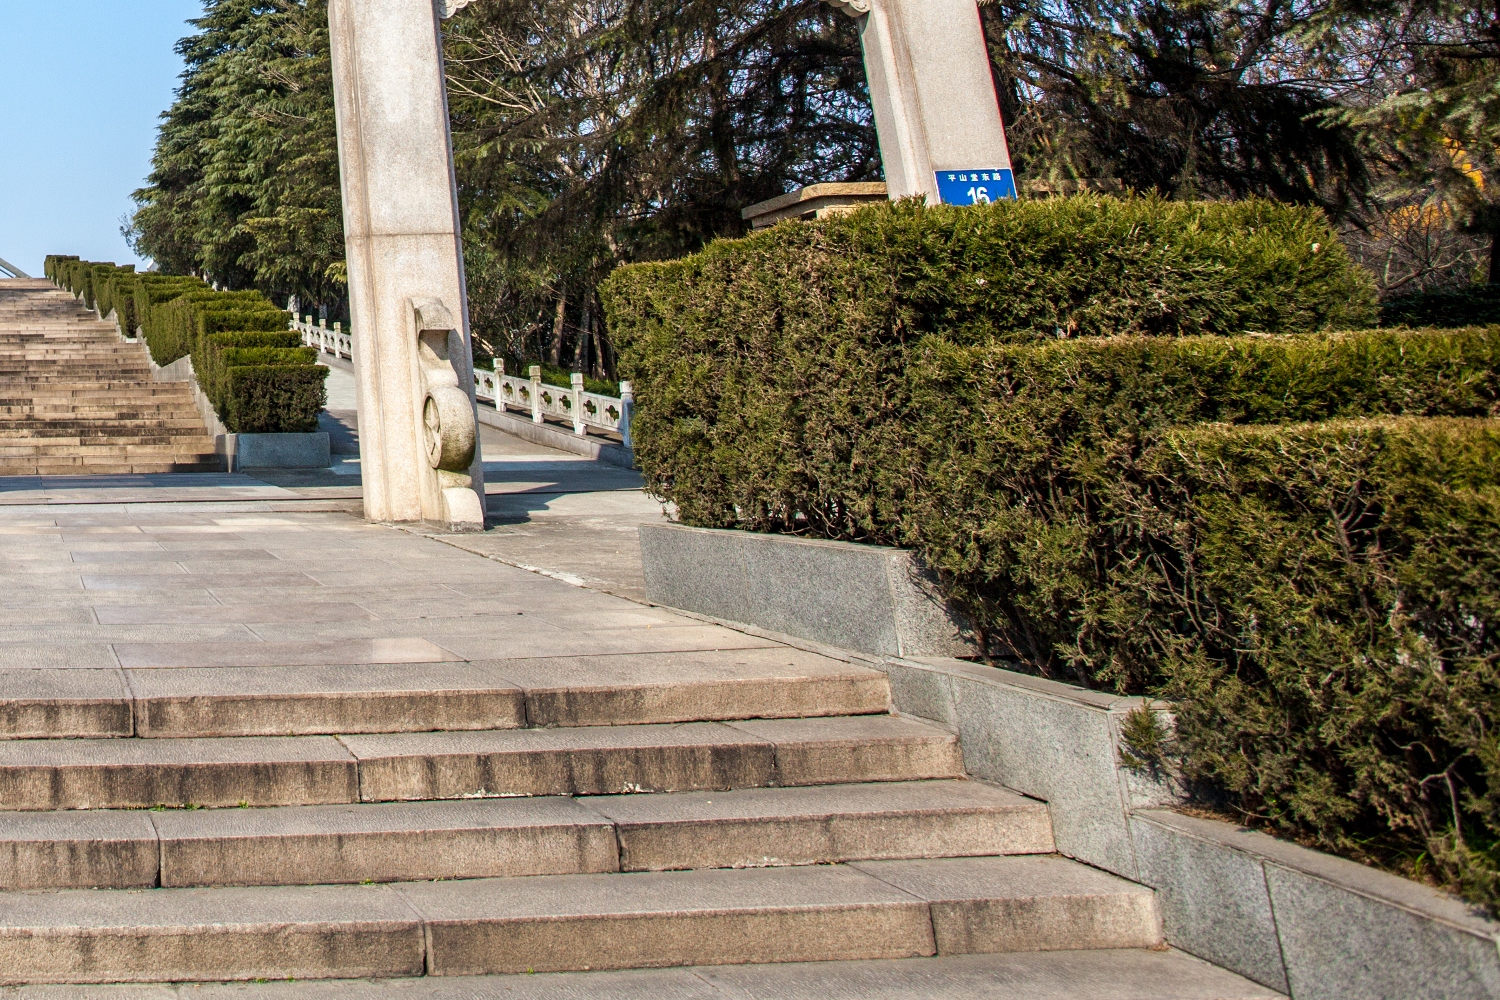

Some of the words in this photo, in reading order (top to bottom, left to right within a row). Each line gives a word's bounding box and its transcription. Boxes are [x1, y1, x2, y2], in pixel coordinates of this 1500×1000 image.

[948, 172, 1001, 182] 平山堂东路
[967, 186, 990, 204] 16
